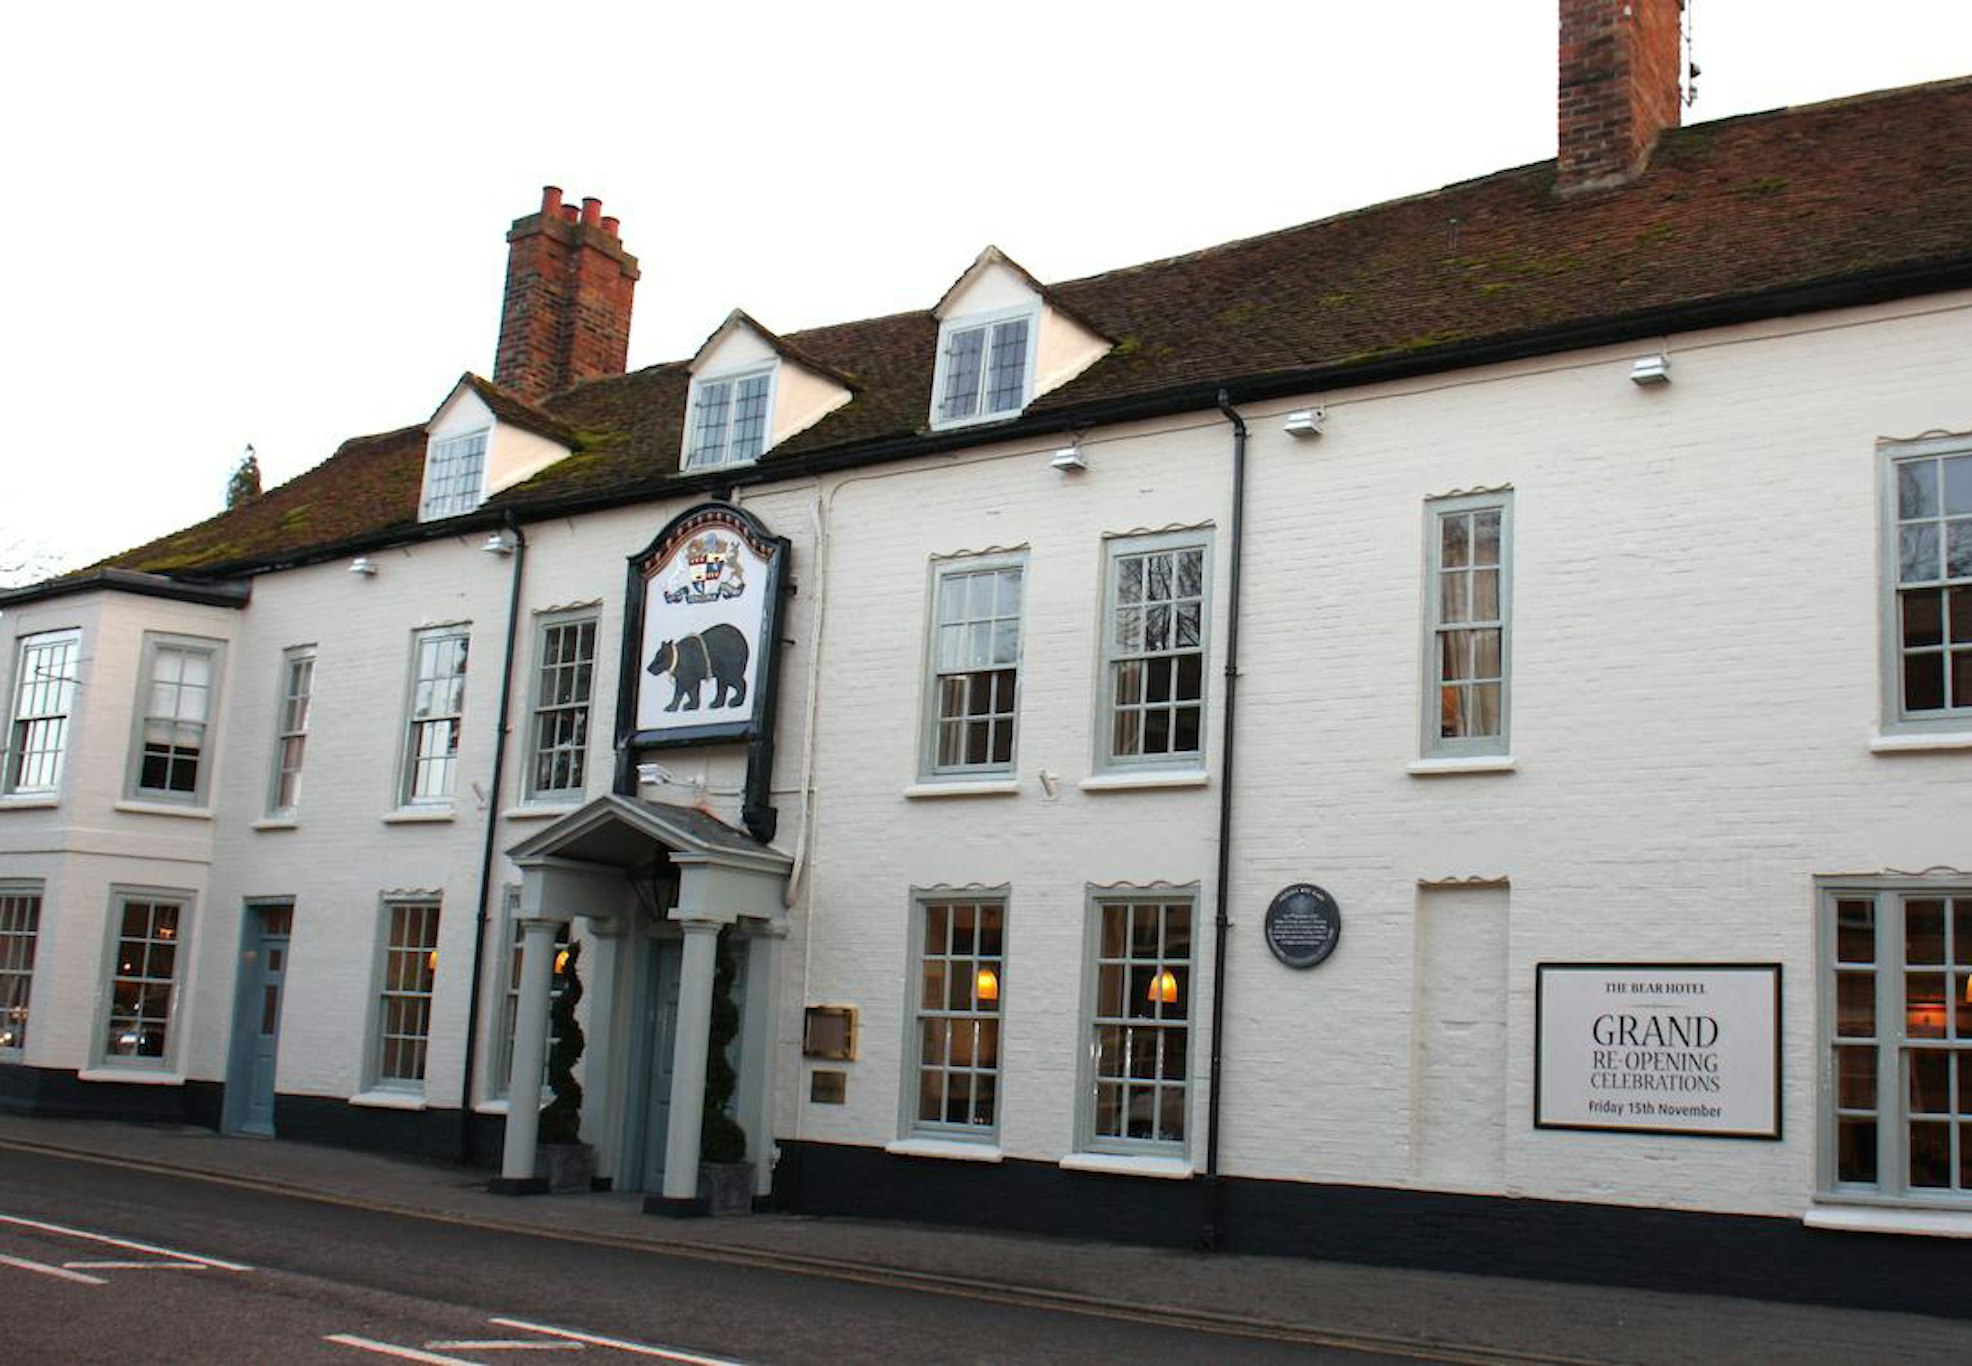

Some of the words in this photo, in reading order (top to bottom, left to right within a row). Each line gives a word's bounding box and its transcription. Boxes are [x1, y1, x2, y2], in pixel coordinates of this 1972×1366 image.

[1605, 982, 1628, 993] THE
[1631, 982, 1662, 994] BEAR
[1665, 983, 1706, 994] HOTEL
[1593, 1014, 1718, 1048] GRAND
[1593, 1050, 1718, 1073] RE-OPENING
[1590, 1072, 1720, 1092] CELEBRATIONS
[1589, 1100, 1624, 1116] Friday
[1629, 1101, 1655, 1115] 15th
[1658, 1103, 1722, 1118] November
